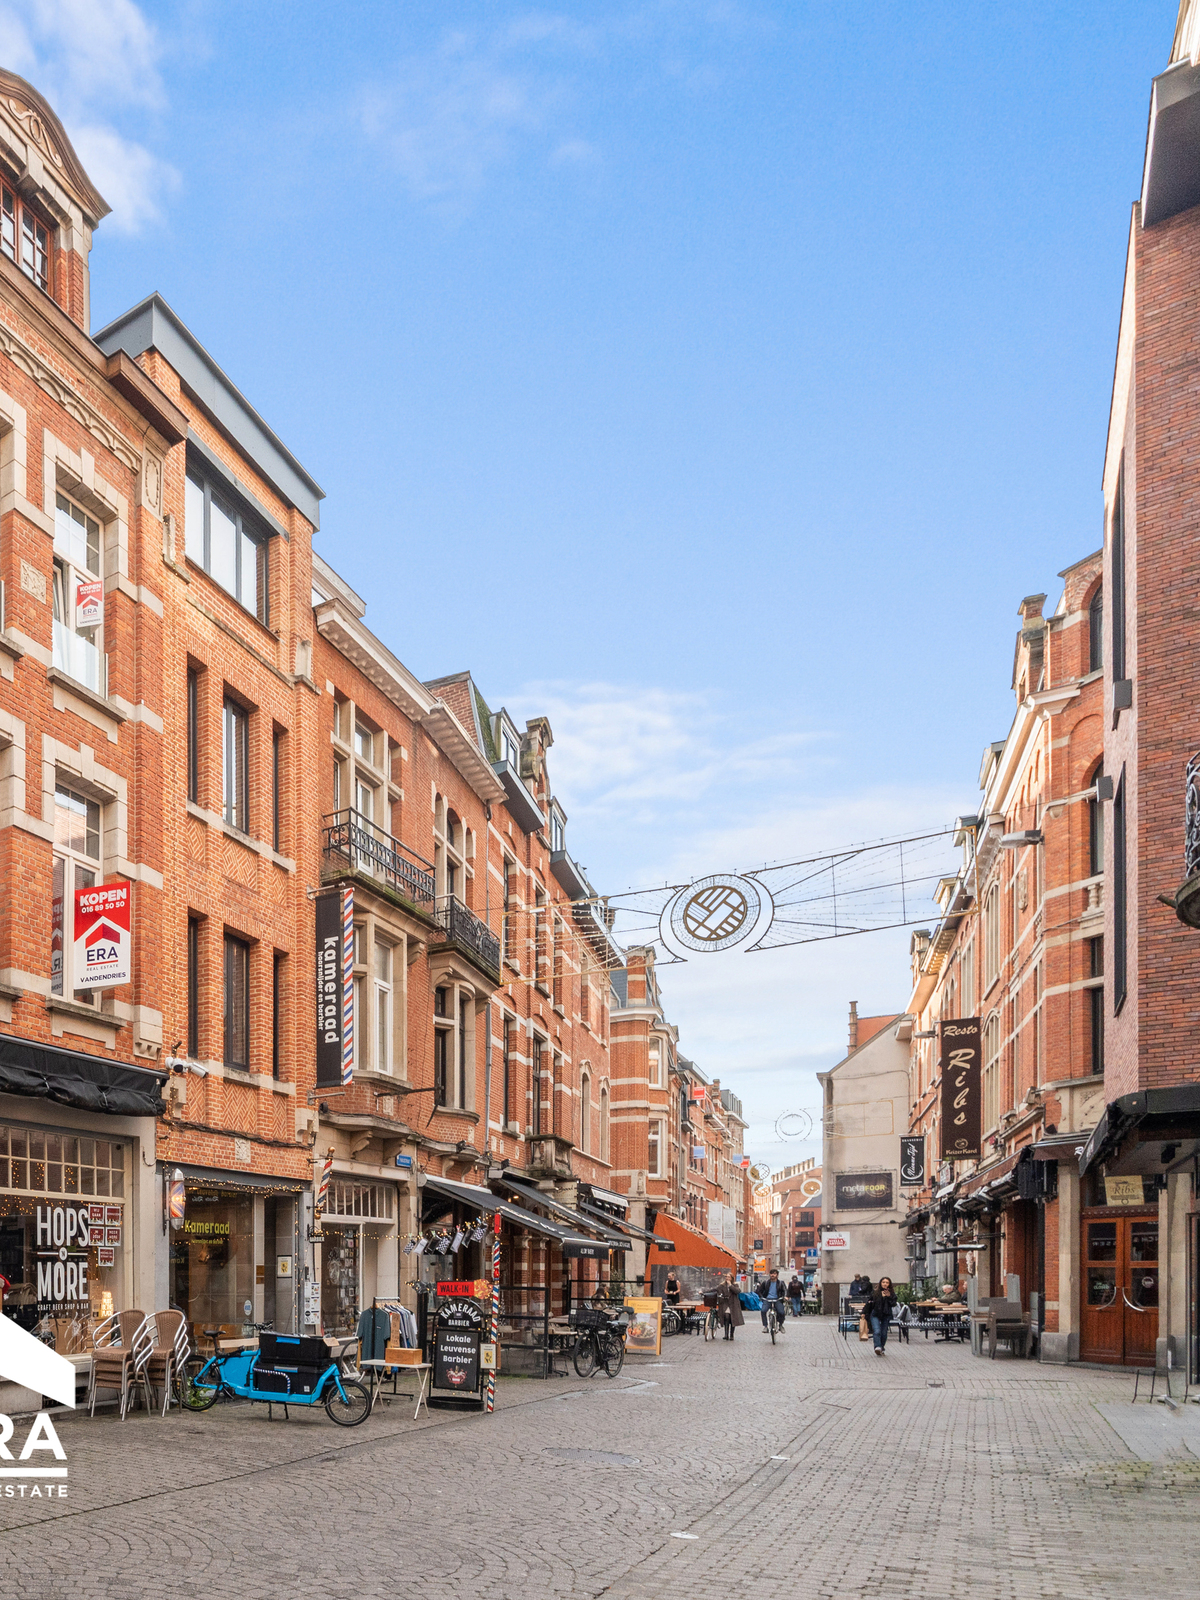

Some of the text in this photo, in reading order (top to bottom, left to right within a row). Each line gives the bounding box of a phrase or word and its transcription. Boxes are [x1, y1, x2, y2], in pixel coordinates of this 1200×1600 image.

[79, 583, 102, 593] KOPEN
[82, 607, 98, 615] ERA
[79, 888, 127, 907] KOPEN
[81, 906, 94, 914] 016
[105, 902, 115, 910] 50
[115, 900, 125, 908] 50
[86, 946, 118, 962] ERA
[80, 971, 126, 983] VANDENDRIES
[324, 935, 340, 1044] kameraad
[318, 993, 324, 1004] en
[943, 1024, 978, 1038] Resto
[842, 1184, 886, 1193] metaFOOR
[36, 1205, 89, 1247] HOPS
[184, 1220, 230, 1235] Kameraad
[37, 1261, 89, 1302] MORE
[440, 1284, 470, 1294] WALK-IN
[441, 1303, 481, 1322] KAMERAAD
[448, 1319, 470, 1327] BARBIER
[446, 1335, 471, 1344] Lokale
[440, 1344, 477, 1354] Leuvense
[442, 1355, 473, 1364] Barbier
